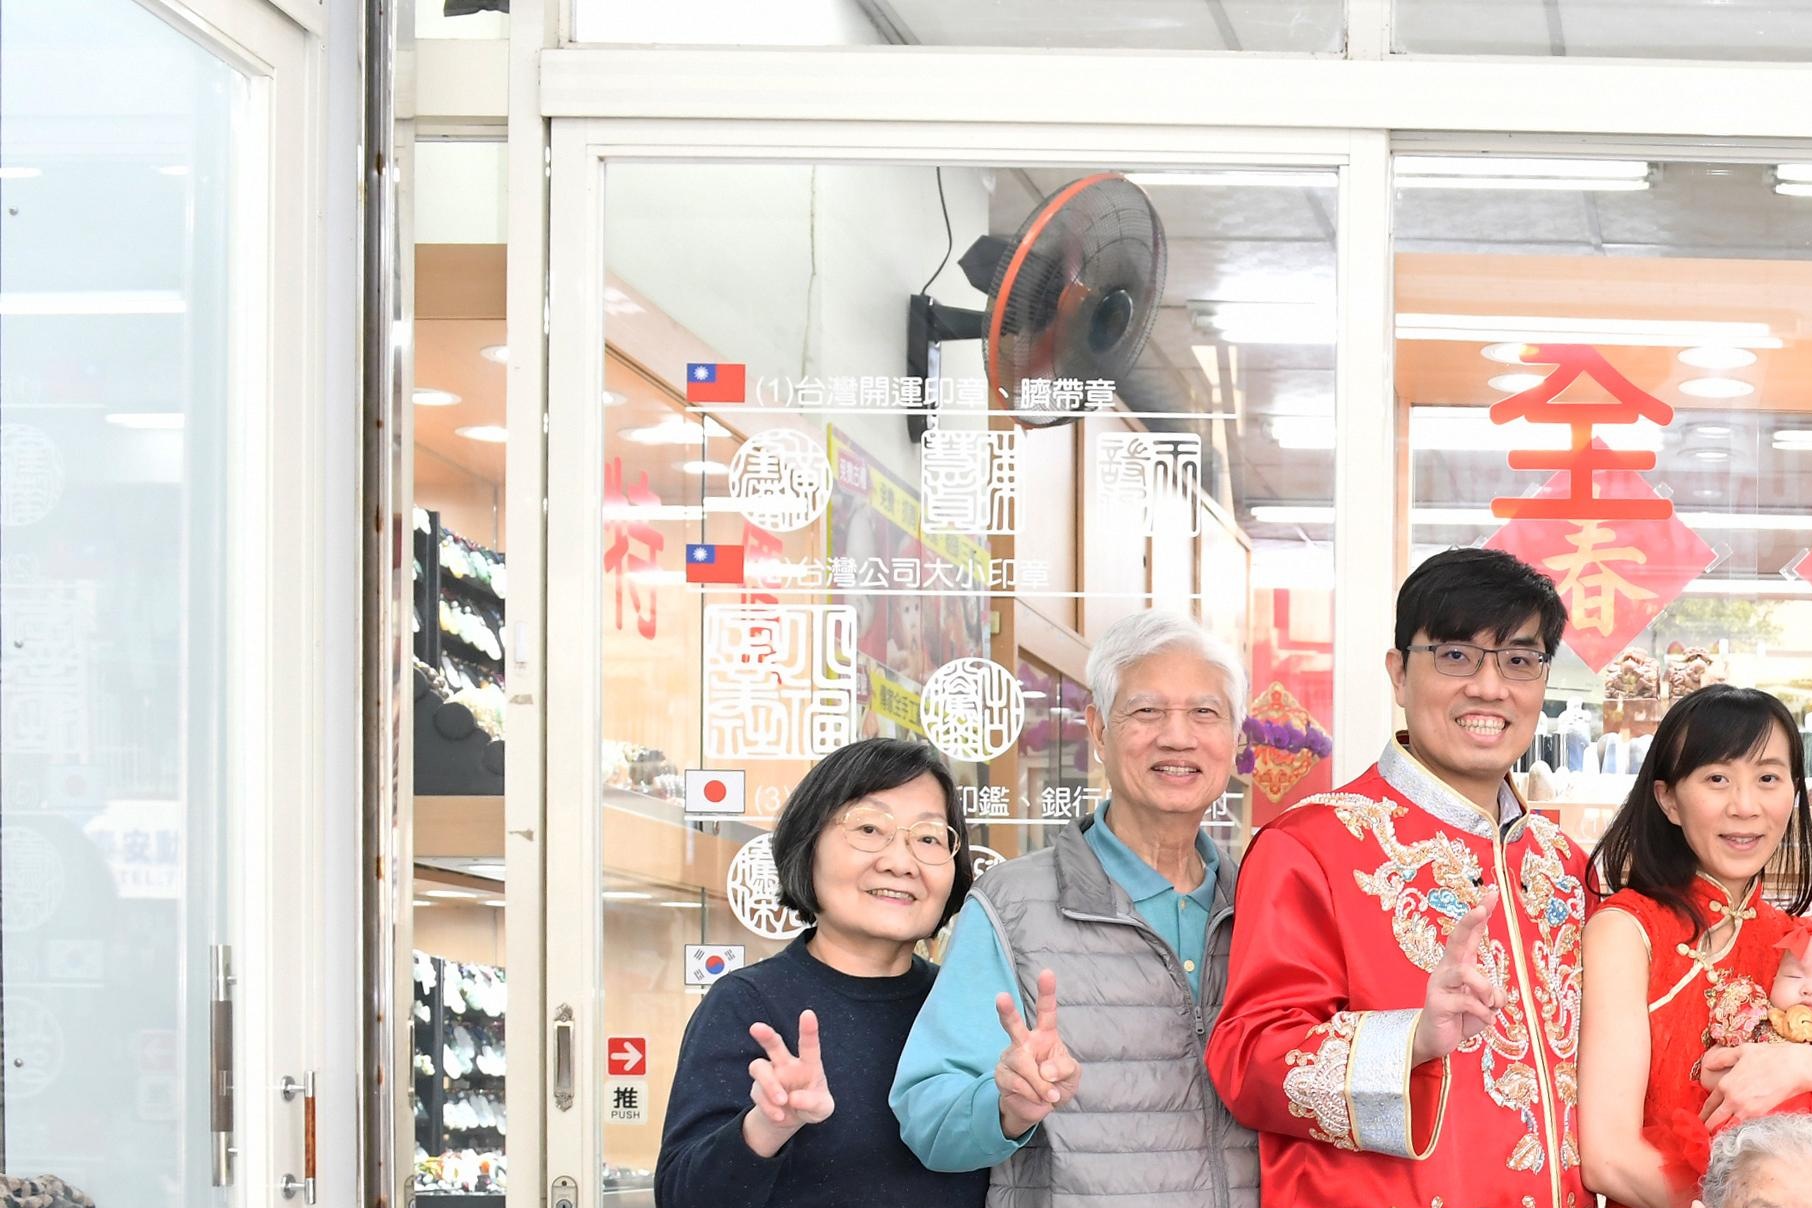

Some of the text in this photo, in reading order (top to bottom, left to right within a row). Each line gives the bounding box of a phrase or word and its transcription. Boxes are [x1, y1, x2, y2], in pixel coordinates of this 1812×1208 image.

[756, 556, 1050, 590] )台灣公司大小印章
[1541, 484, 1660, 638] 春
[612, 1086, 638, 1109] 推
[610, 1110, 640, 1119] PUSH
